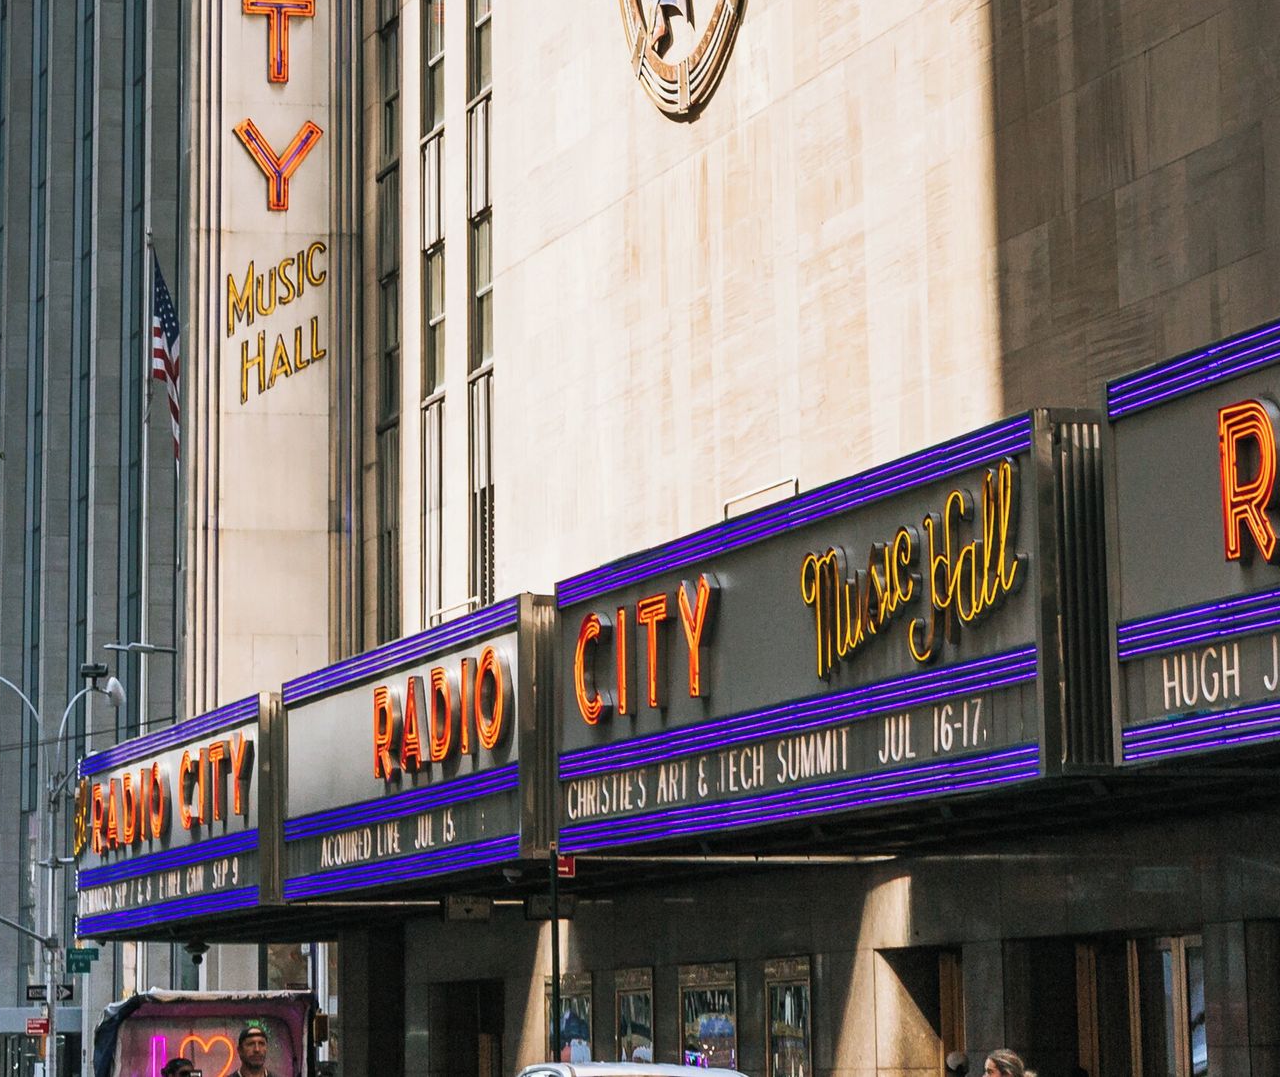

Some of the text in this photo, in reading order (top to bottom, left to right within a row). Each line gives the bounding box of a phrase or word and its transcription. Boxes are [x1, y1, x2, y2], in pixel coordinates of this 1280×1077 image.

[226, 241, 328, 336] MUSIC
[239, 316, 327, 405] HALL
[800, 457, 1023, 679] Music Hall
[574, 573, 716, 725] CITY
[1162, 642, 1242, 710] HUGH
[373, 645, 509, 783] RADIO
[92, 761, 165, 856] RADIO
[179, 729, 252, 831] CITY
[567, 768, 647, 820] CHRISTIE'S
[657, 761, 690, 804] ART
[697, 756, 709, 798] &
[719, 744, 764, 792] TECH
[776, 726, 851, 783] SUMMIT
[878, 713, 916, 764] JUL
[212, 858, 229, 890] SEP
[231, 857, 239, 886] 9
[320, 827, 372, 868] ACQUIRED
[377, 821, 401, 857] LIVE
[414, 814, 435, 849] JUL
